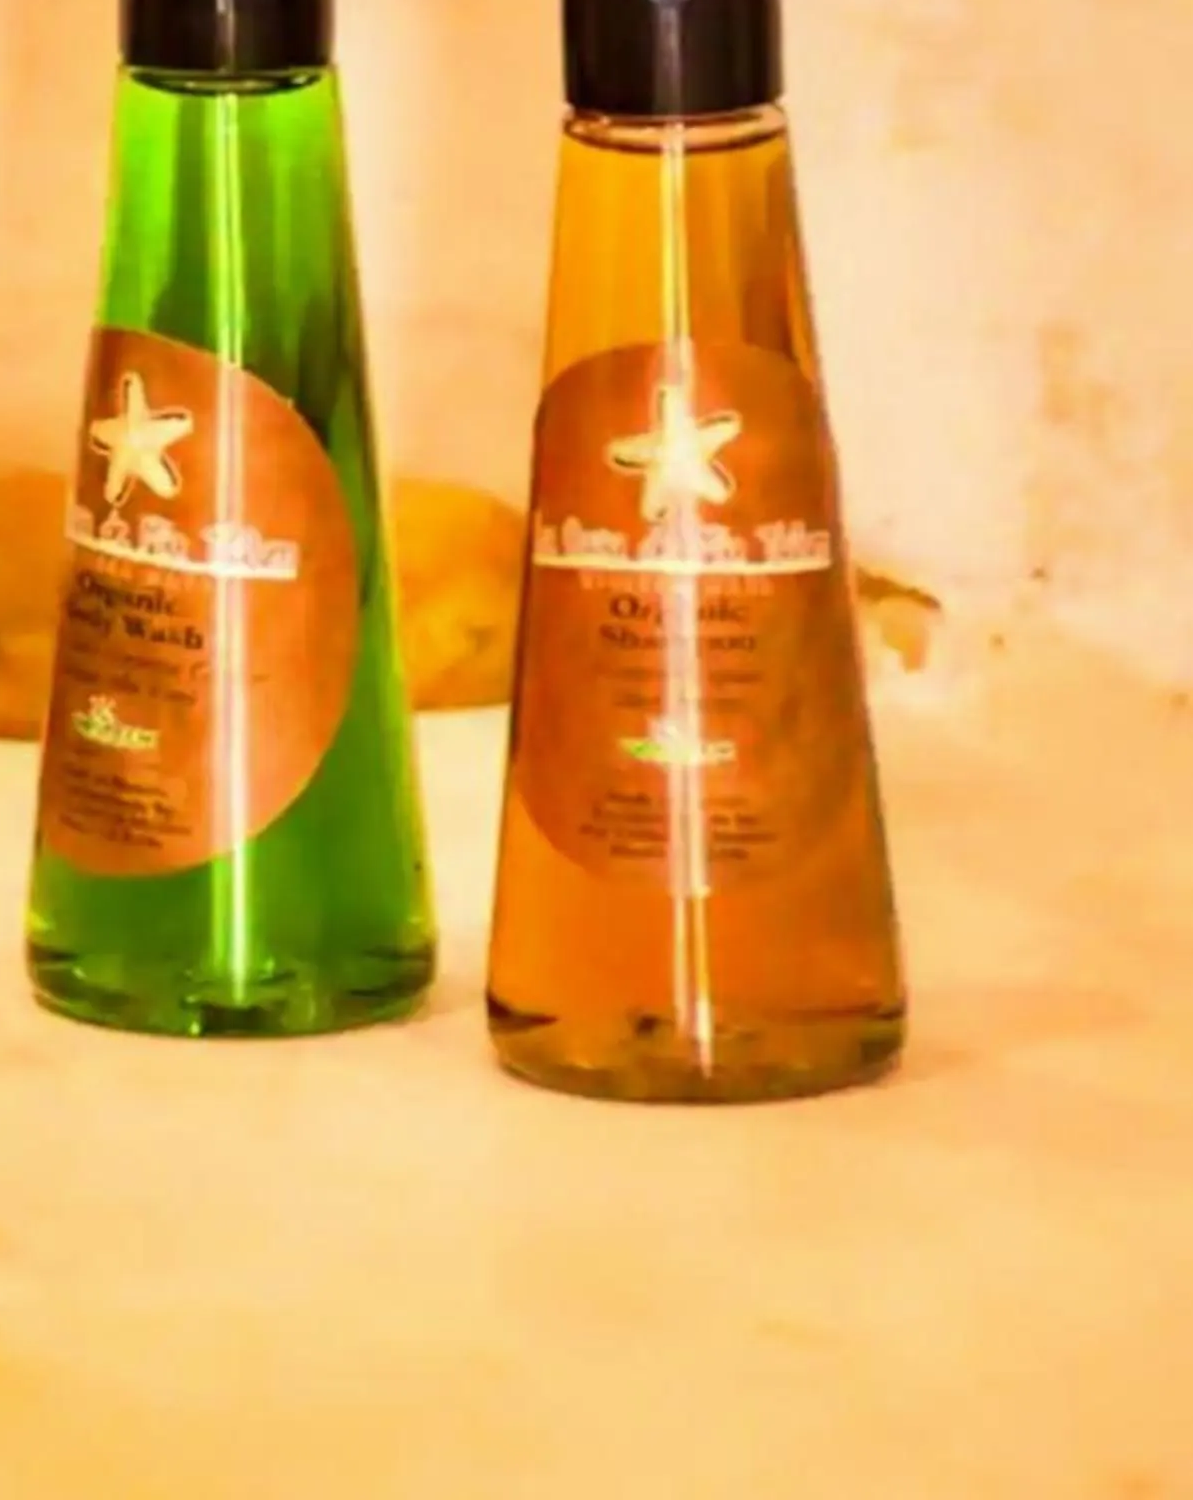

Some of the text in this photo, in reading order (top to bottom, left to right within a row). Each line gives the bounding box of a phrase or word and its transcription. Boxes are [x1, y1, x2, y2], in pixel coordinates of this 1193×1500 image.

[609, 593, 749, 627] Ornic
[120, 614, 204, 650] Wash
[599, 622, 757, 658] Shapoo
